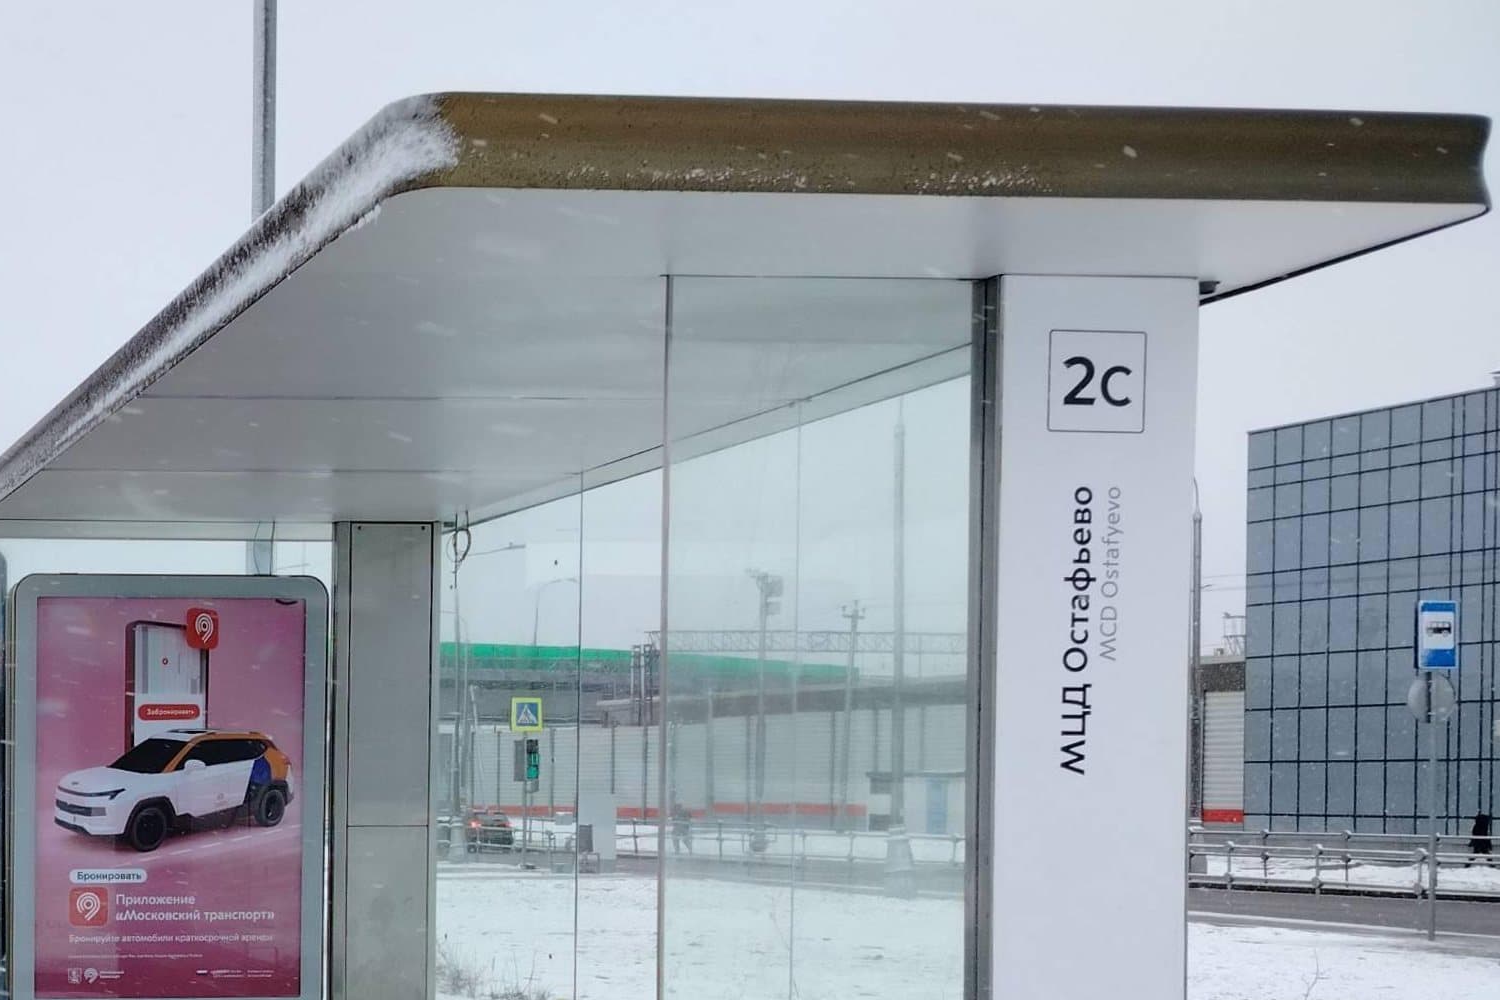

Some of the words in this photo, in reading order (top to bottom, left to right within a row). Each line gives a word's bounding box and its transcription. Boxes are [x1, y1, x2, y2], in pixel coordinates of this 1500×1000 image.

[1100, 486, 1124, 599] Ostafyevo
[1062, 486, 1097, 673] Остафьево
[1100, 605, 1118, 661] MCD
[1060, 683, 1093, 775] МЦД
[76, 871, 142, 881] Бронировать
[115, 909, 201, 921] «Московский
[204, 911, 275, 922] транспорт»
[116, 894, 195, 905] Приложение
[122, 934, 173, 942] автомобили
